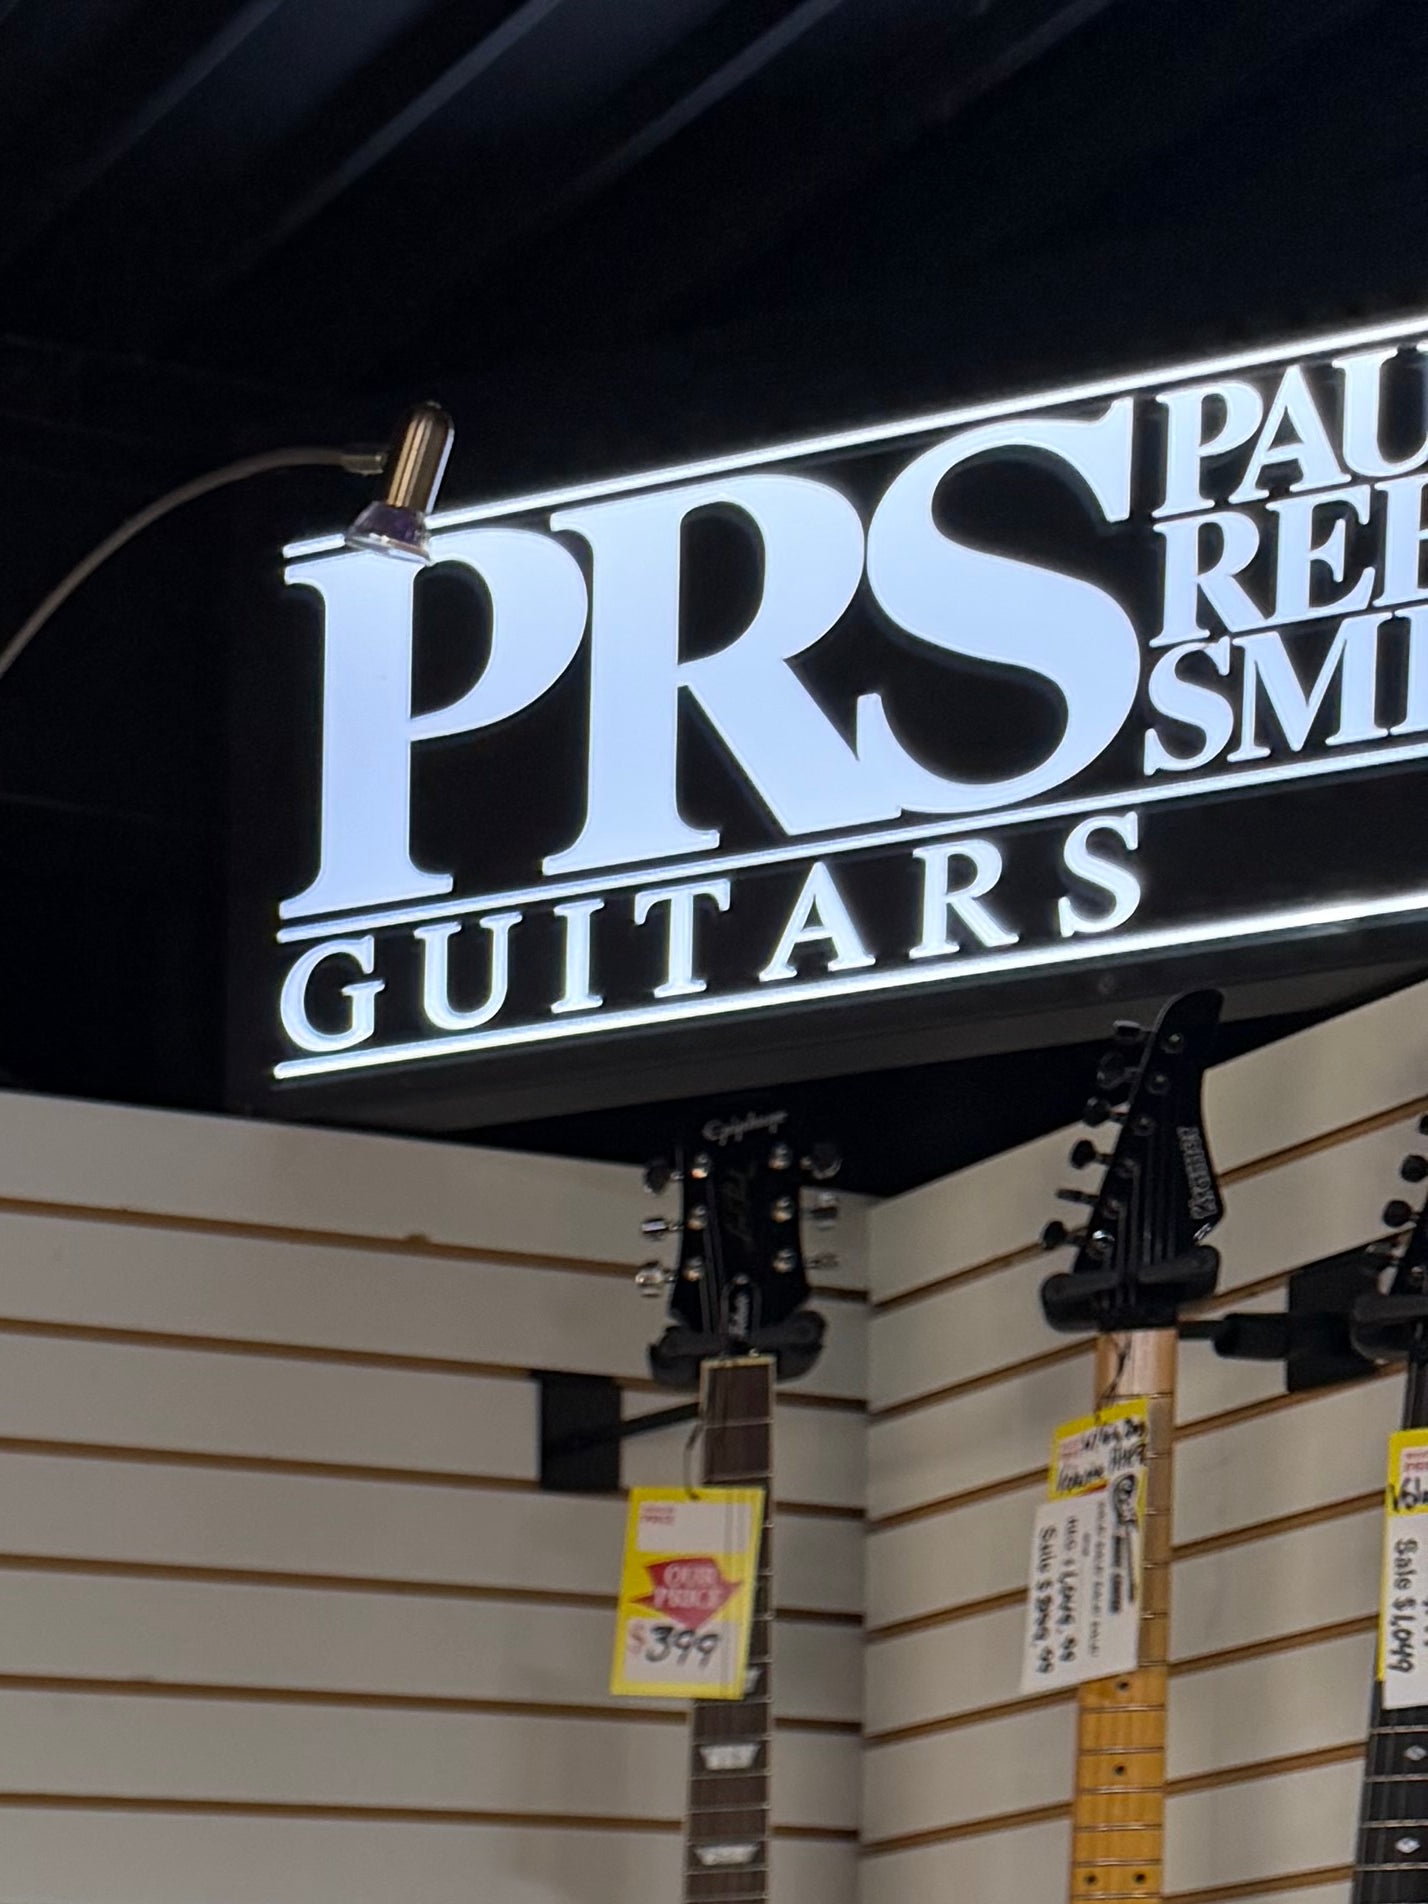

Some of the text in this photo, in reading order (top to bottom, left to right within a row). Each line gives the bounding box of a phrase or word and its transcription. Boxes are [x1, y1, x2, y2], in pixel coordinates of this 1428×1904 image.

[1152, 342, 1428, 519] PAU
[278, 395, 1142, 920] PRS
[1144, 604, 1428, 777] SMI
[278, 810, 1142, 1055] GUITARS
[652, 1585, 723, 1610] PRICE
[662, 1562, 719, 1587] OUR
